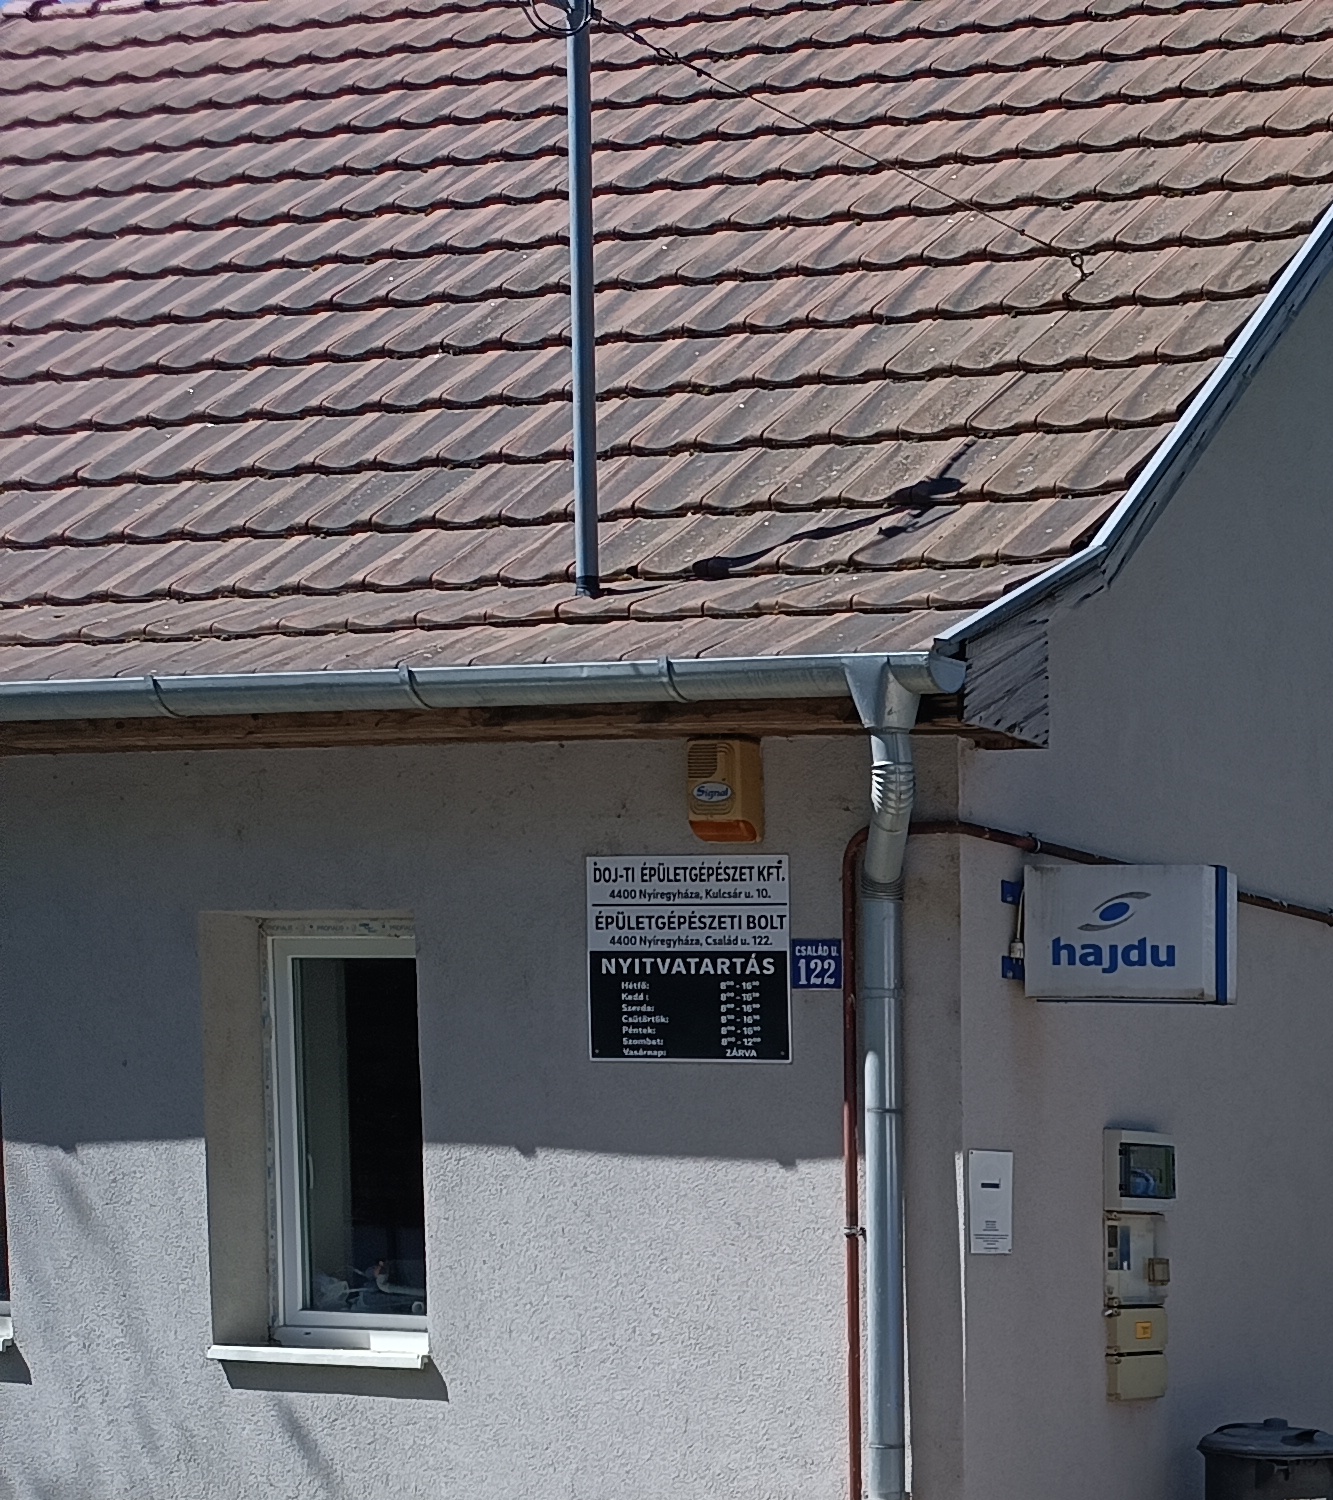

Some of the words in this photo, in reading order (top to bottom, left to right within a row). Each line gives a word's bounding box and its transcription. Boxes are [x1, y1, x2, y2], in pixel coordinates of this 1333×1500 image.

[593, 866, 636, 883] DOJ-TI
[640, 861, 755, 883] ÉPÜLETGÉPÉSZET
[758, 865, 786, 882] KFT.
[609, 889, 637, 899] 4400
[639, 888, 703, 902] Nyíregyháza,
[705, 888, 743, 899] Kulcsár
[745, 890, 754, 899] u.
[756, 888, 772, 899] 10.
[595, 911, 742, 930] ÉPÜLETGÉPÉSZETI
[747, 914, 787, 930] BOLT
[609, 936, 637, 946] 4400
[639, 935, 703, 949] Nyíregyháza,
[705, 935, 739, 946] Család
[740, 938, 750, 946] u.
[752, 936, 773, 946] 122.
[795, 942, 829, 956] CSALÁD
[601, 952, 775, 975] NYITVATARTÁS
[1051, 936, 1176, 974] hajdu
[798, 958, 836, 985] 122
[725, 1046, 757, 1057] ZÁRVA
